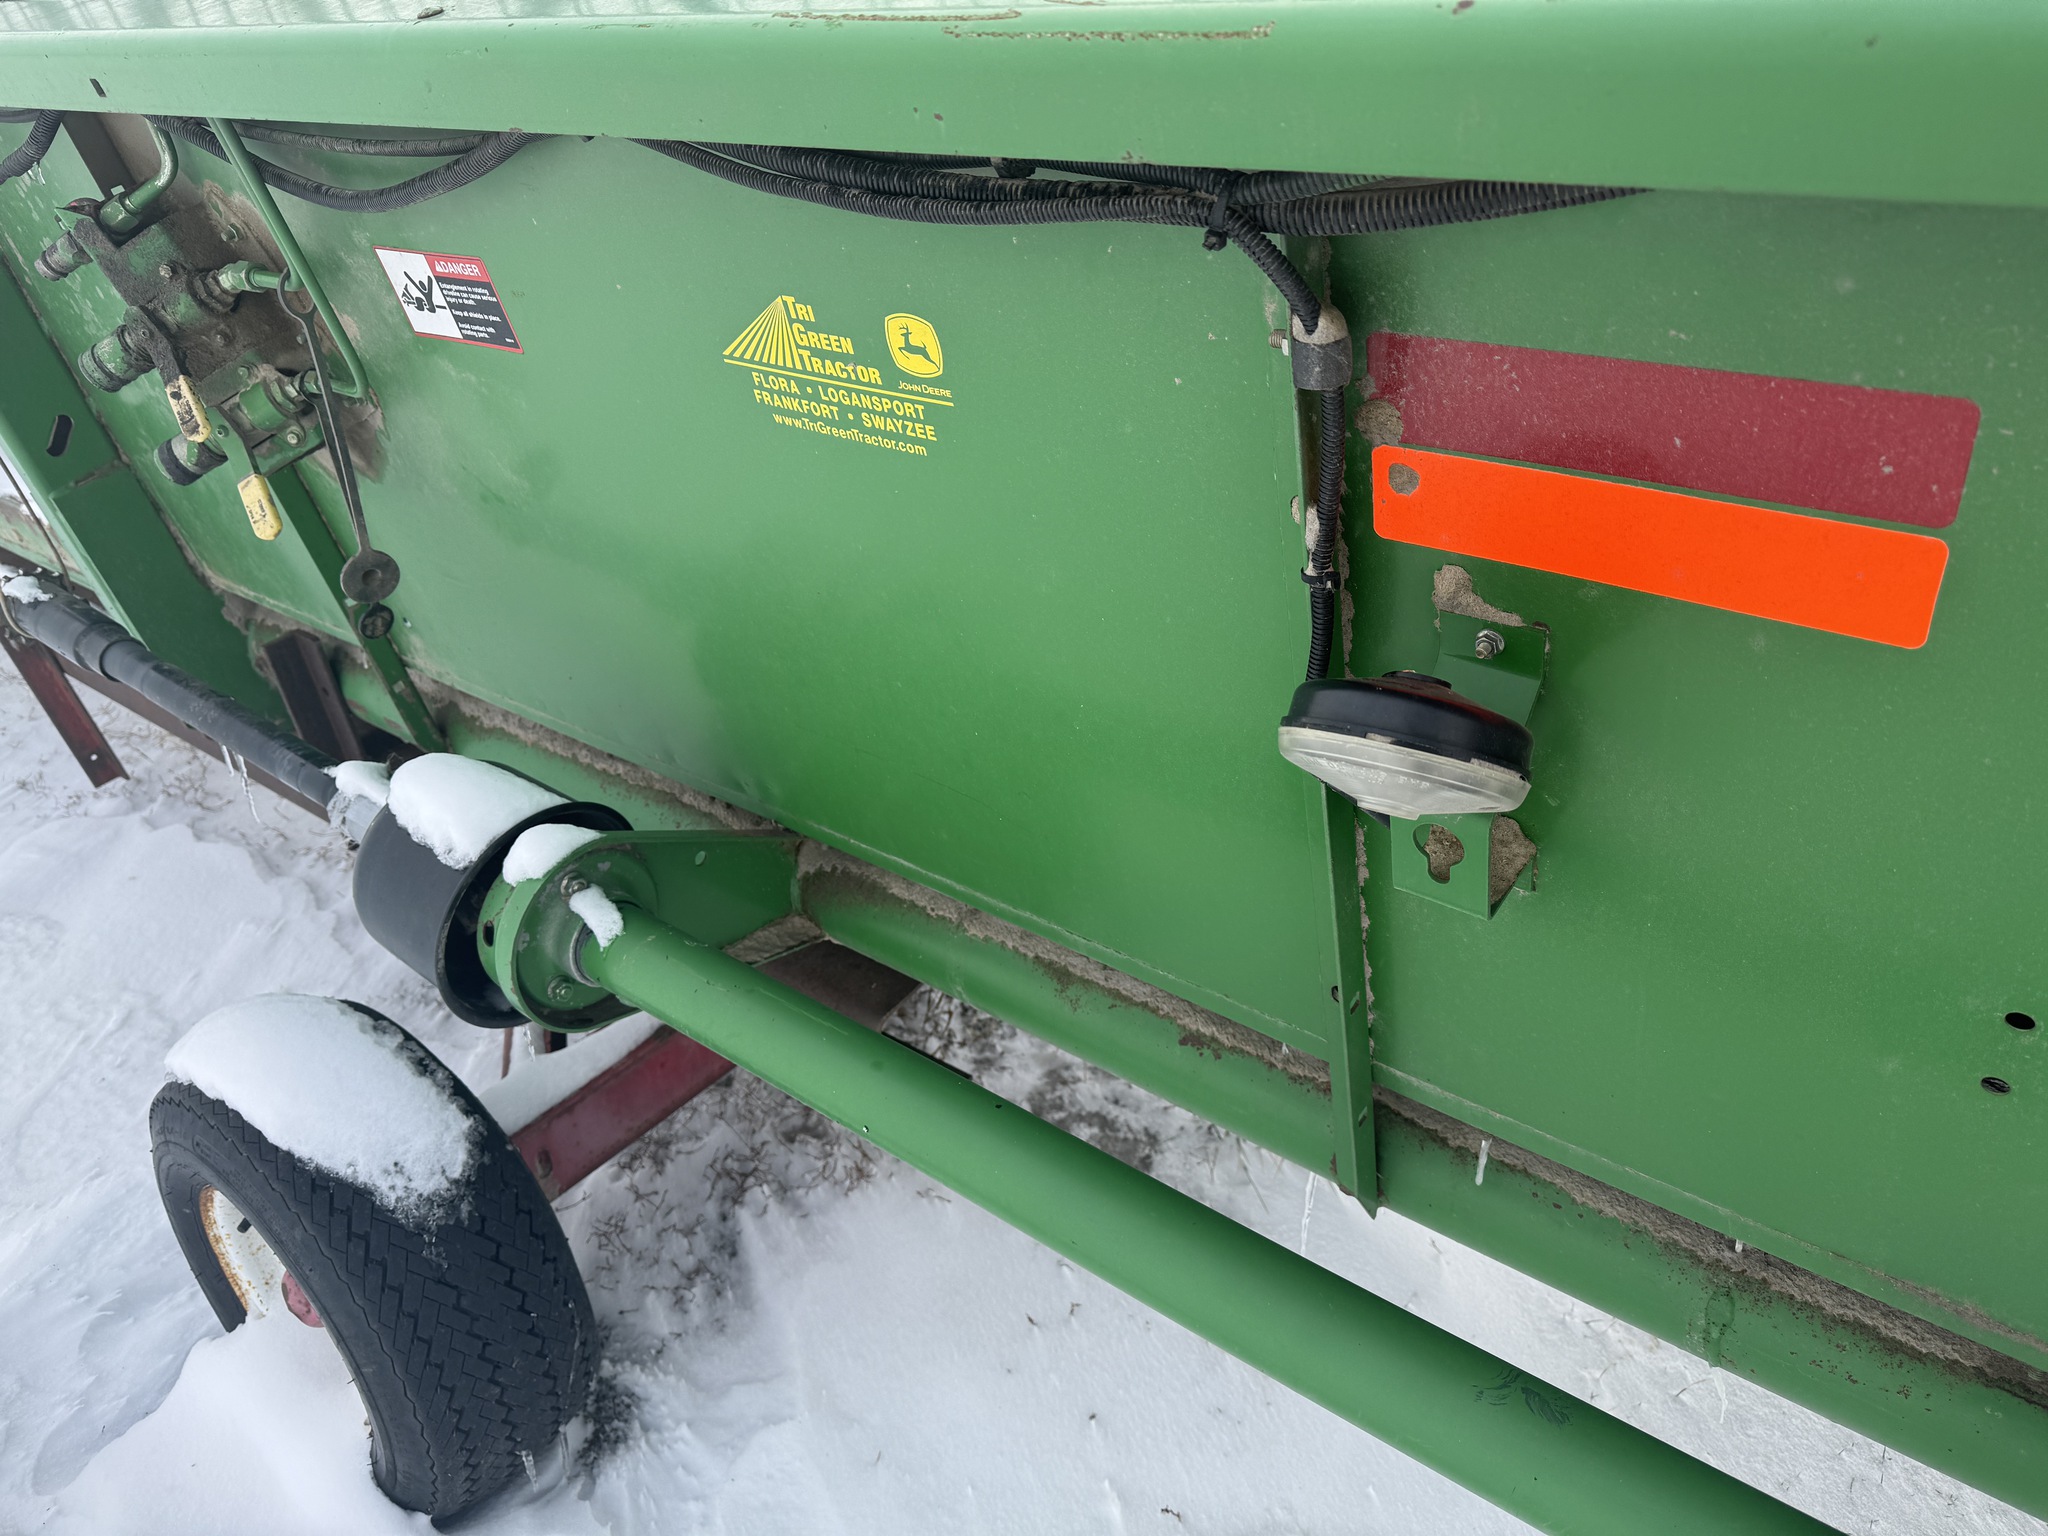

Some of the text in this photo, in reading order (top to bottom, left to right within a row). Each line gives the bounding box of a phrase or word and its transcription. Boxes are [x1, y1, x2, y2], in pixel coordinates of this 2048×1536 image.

[439, 261, 481, 276] DANGER
[782, 295, 815, 322] TRI
[793, 322, 855, 354] GREEN
[798, 348, 883, 385] TRACTOR
[752, 371, 925, 420] FLORA LOGANSPORT
[898, 381, 952, 397] JOHN DEERE
[753, 389, 937, 441] FRANKFORT SWAYZEE
[773, 413, 927, 456] www.TriGreenTractor.com
